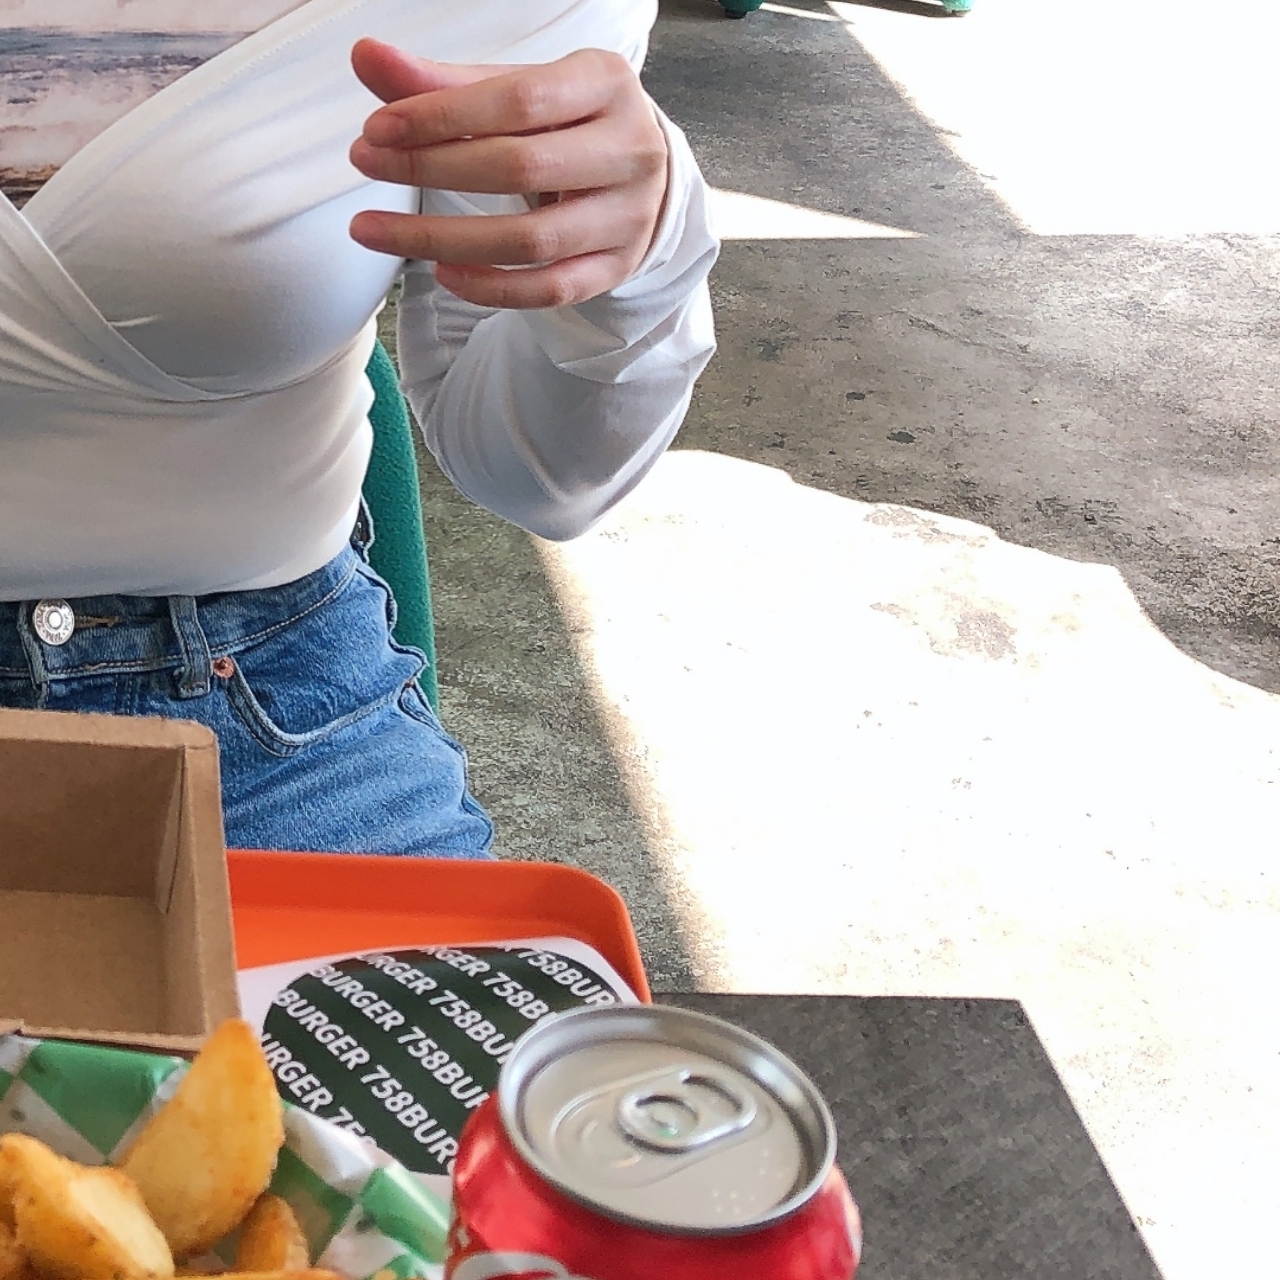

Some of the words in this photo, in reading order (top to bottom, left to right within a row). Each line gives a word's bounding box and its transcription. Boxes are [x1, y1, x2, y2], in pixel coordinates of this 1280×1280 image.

[309, 964, 405, 1032] BURGER
[274, 987, 371, 1071] BURGER
[359, 1064, 458, 1176] 758BUR
